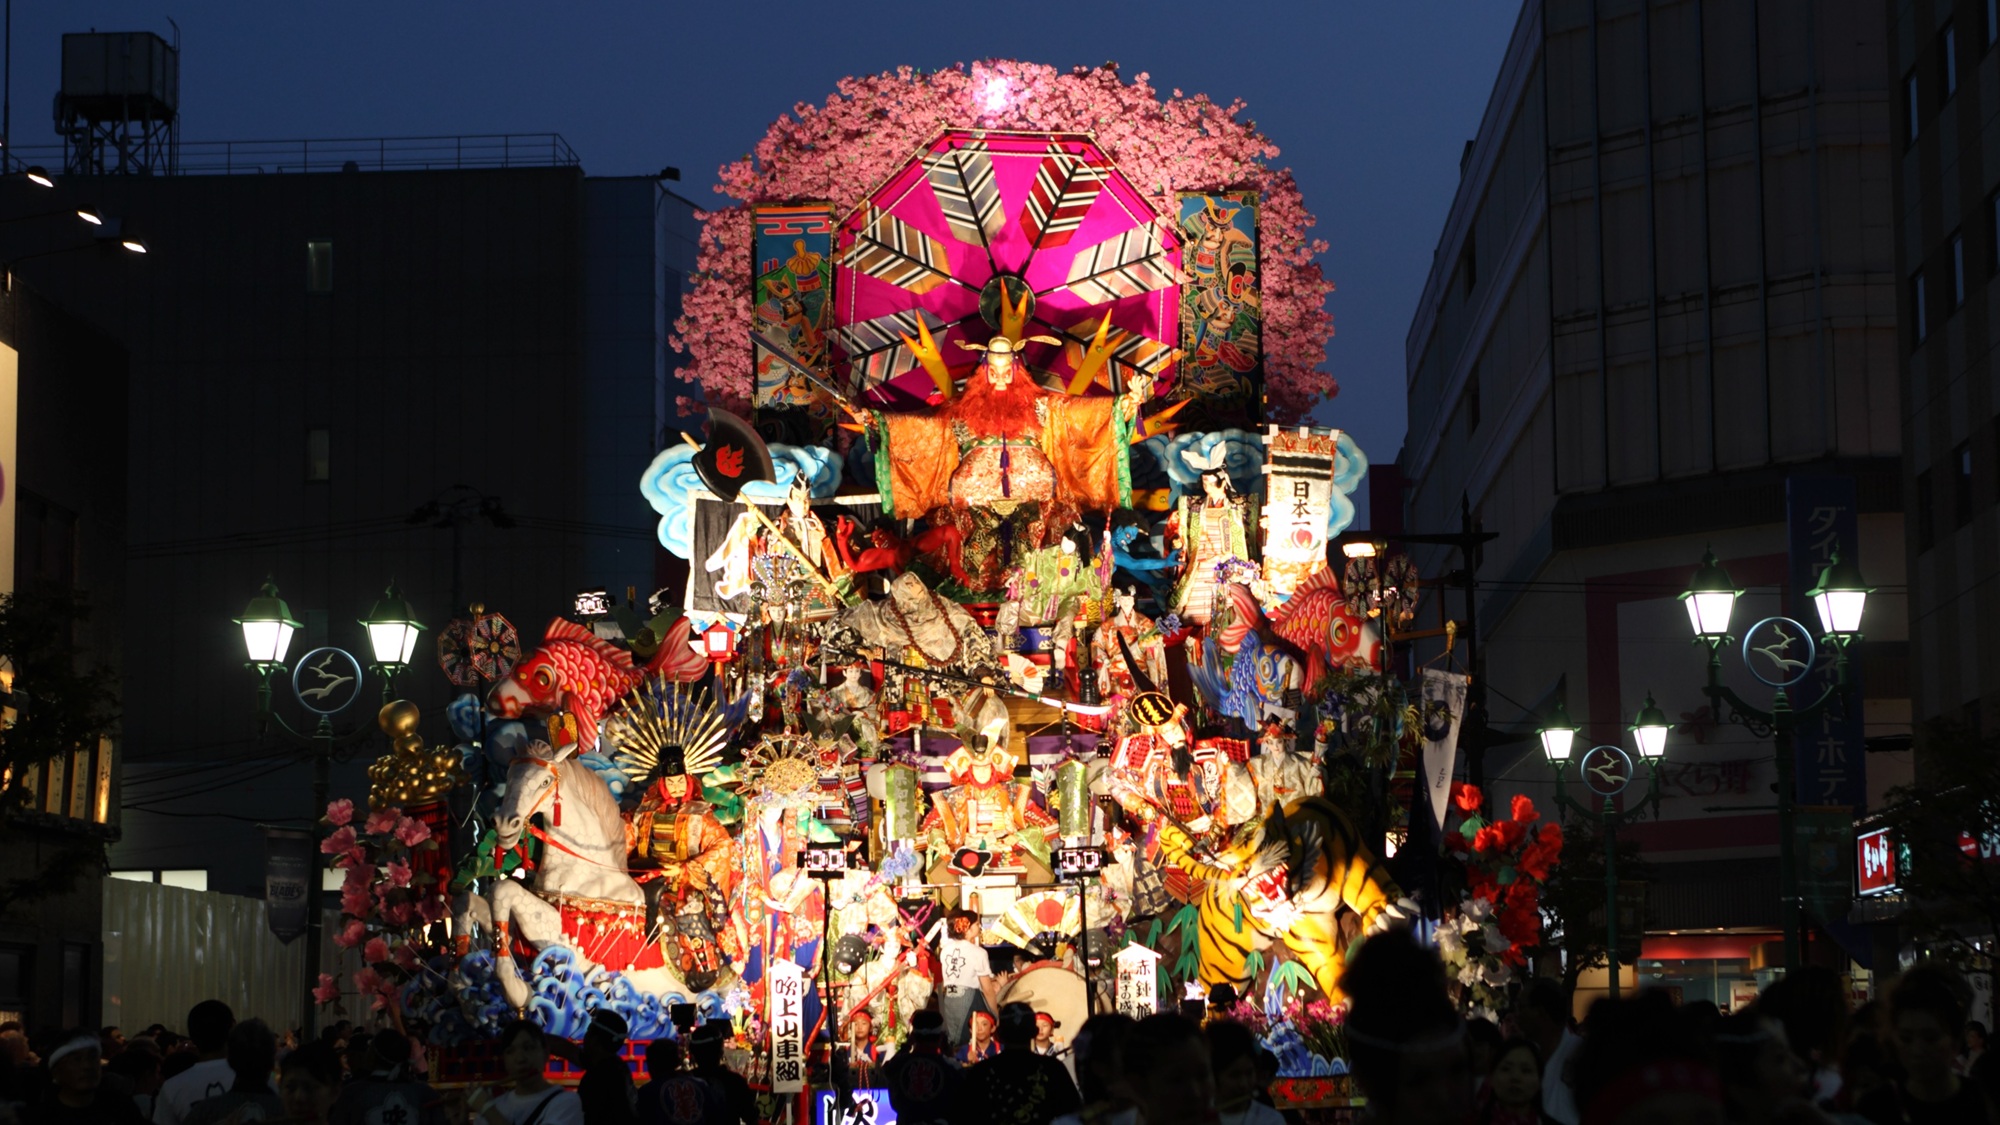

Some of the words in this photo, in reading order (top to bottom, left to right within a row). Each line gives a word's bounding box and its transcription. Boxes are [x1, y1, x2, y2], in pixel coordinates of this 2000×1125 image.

[1291, 480, 1320, 526] 日本一
[775, 976, 800, 1082] 吹上山車組
